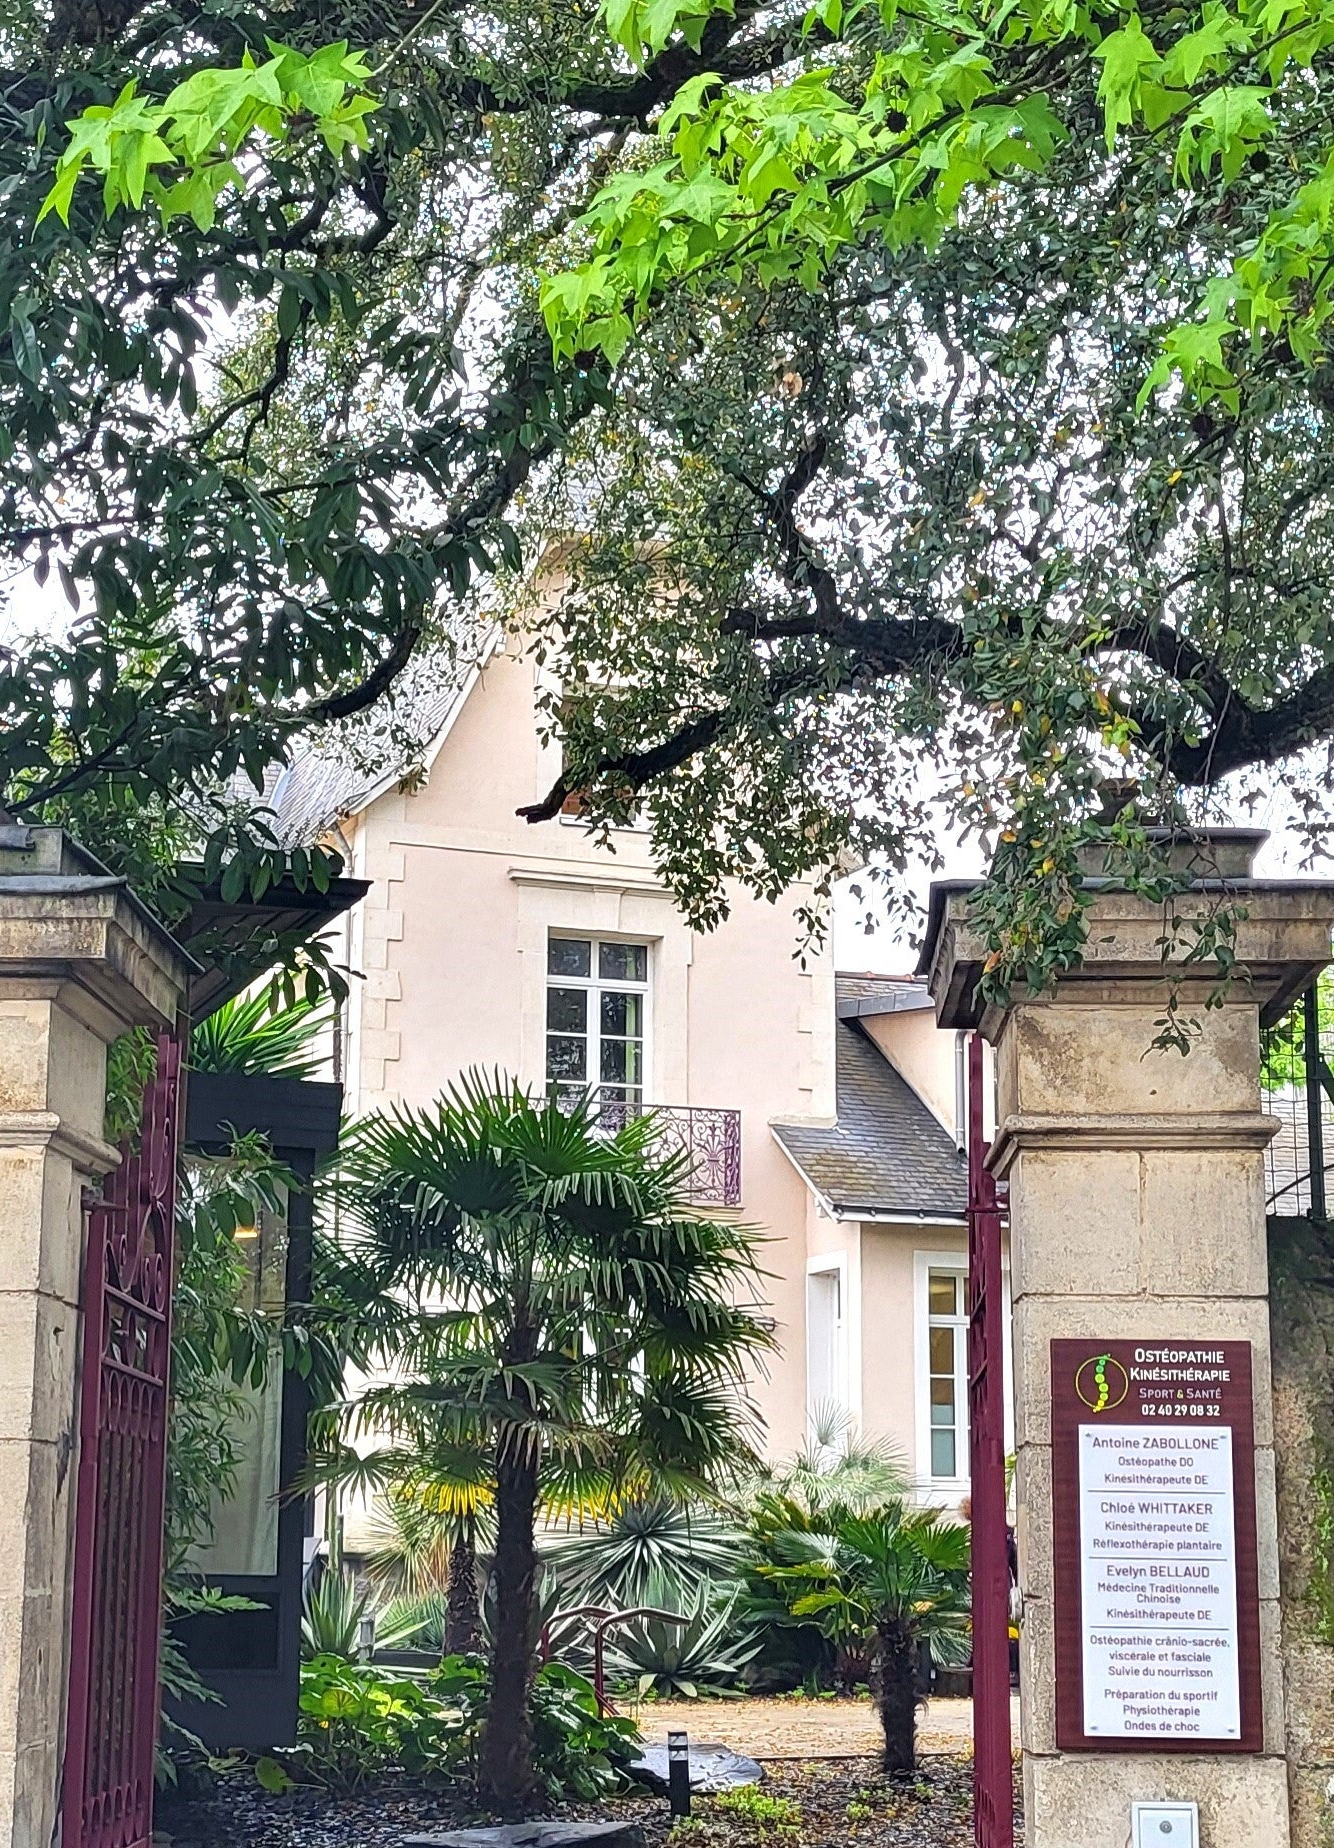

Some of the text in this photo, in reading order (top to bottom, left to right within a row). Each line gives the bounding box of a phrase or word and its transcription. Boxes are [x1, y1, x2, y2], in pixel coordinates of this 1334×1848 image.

[1134, 1348, 1225, 1364] OSTÉOPATHIE
[1130, 1367, 1230, 1382] KINÉSITHÉRAPIE
[1139, 1387, 1222, 1399] SPORT & SANTÉ
[1141, 1404, 1221, 1416] 02 40 29 08 32
[1092, 1437, 1219, 1450] Antoine ZABOLLONE
[1118, 1456, 1194, 1468] Ostéopathe DO
[1104, 1474, 1208, 1486] Kinésithérapeute DE
[1100, 1501, 1213, 1515] Chloé WHITTAKER
[1105, 1521, 1209, 1534] Kinésithérapeute DE
[1093, 1538, 1222, 1551] Réflexothérapie plantaire
[1107, 1565, 1210, 1579] Evelyn BELLAUD
[1097, 1582, 1220, 1594] Médecine Traditionnelle
[1136, 1594, 1181, 1604] Chinoise
[1106, 1609, 1212, 1621] Kinésithérapeute DE
[1090, 1634, 1153, 1646] Ostéopathie
[1109, 1650, 1212, 1662] viscérale et fasciale
[1108, 1666, 1213, 1677] Suivie du nourrisson
[1104, 1689, 1218, 1702] Préparation du sportif
[1123, 1705, 1200, 1717] Physiothérapie
[1124, 1720, 1200, 1731] Ondes de choc
